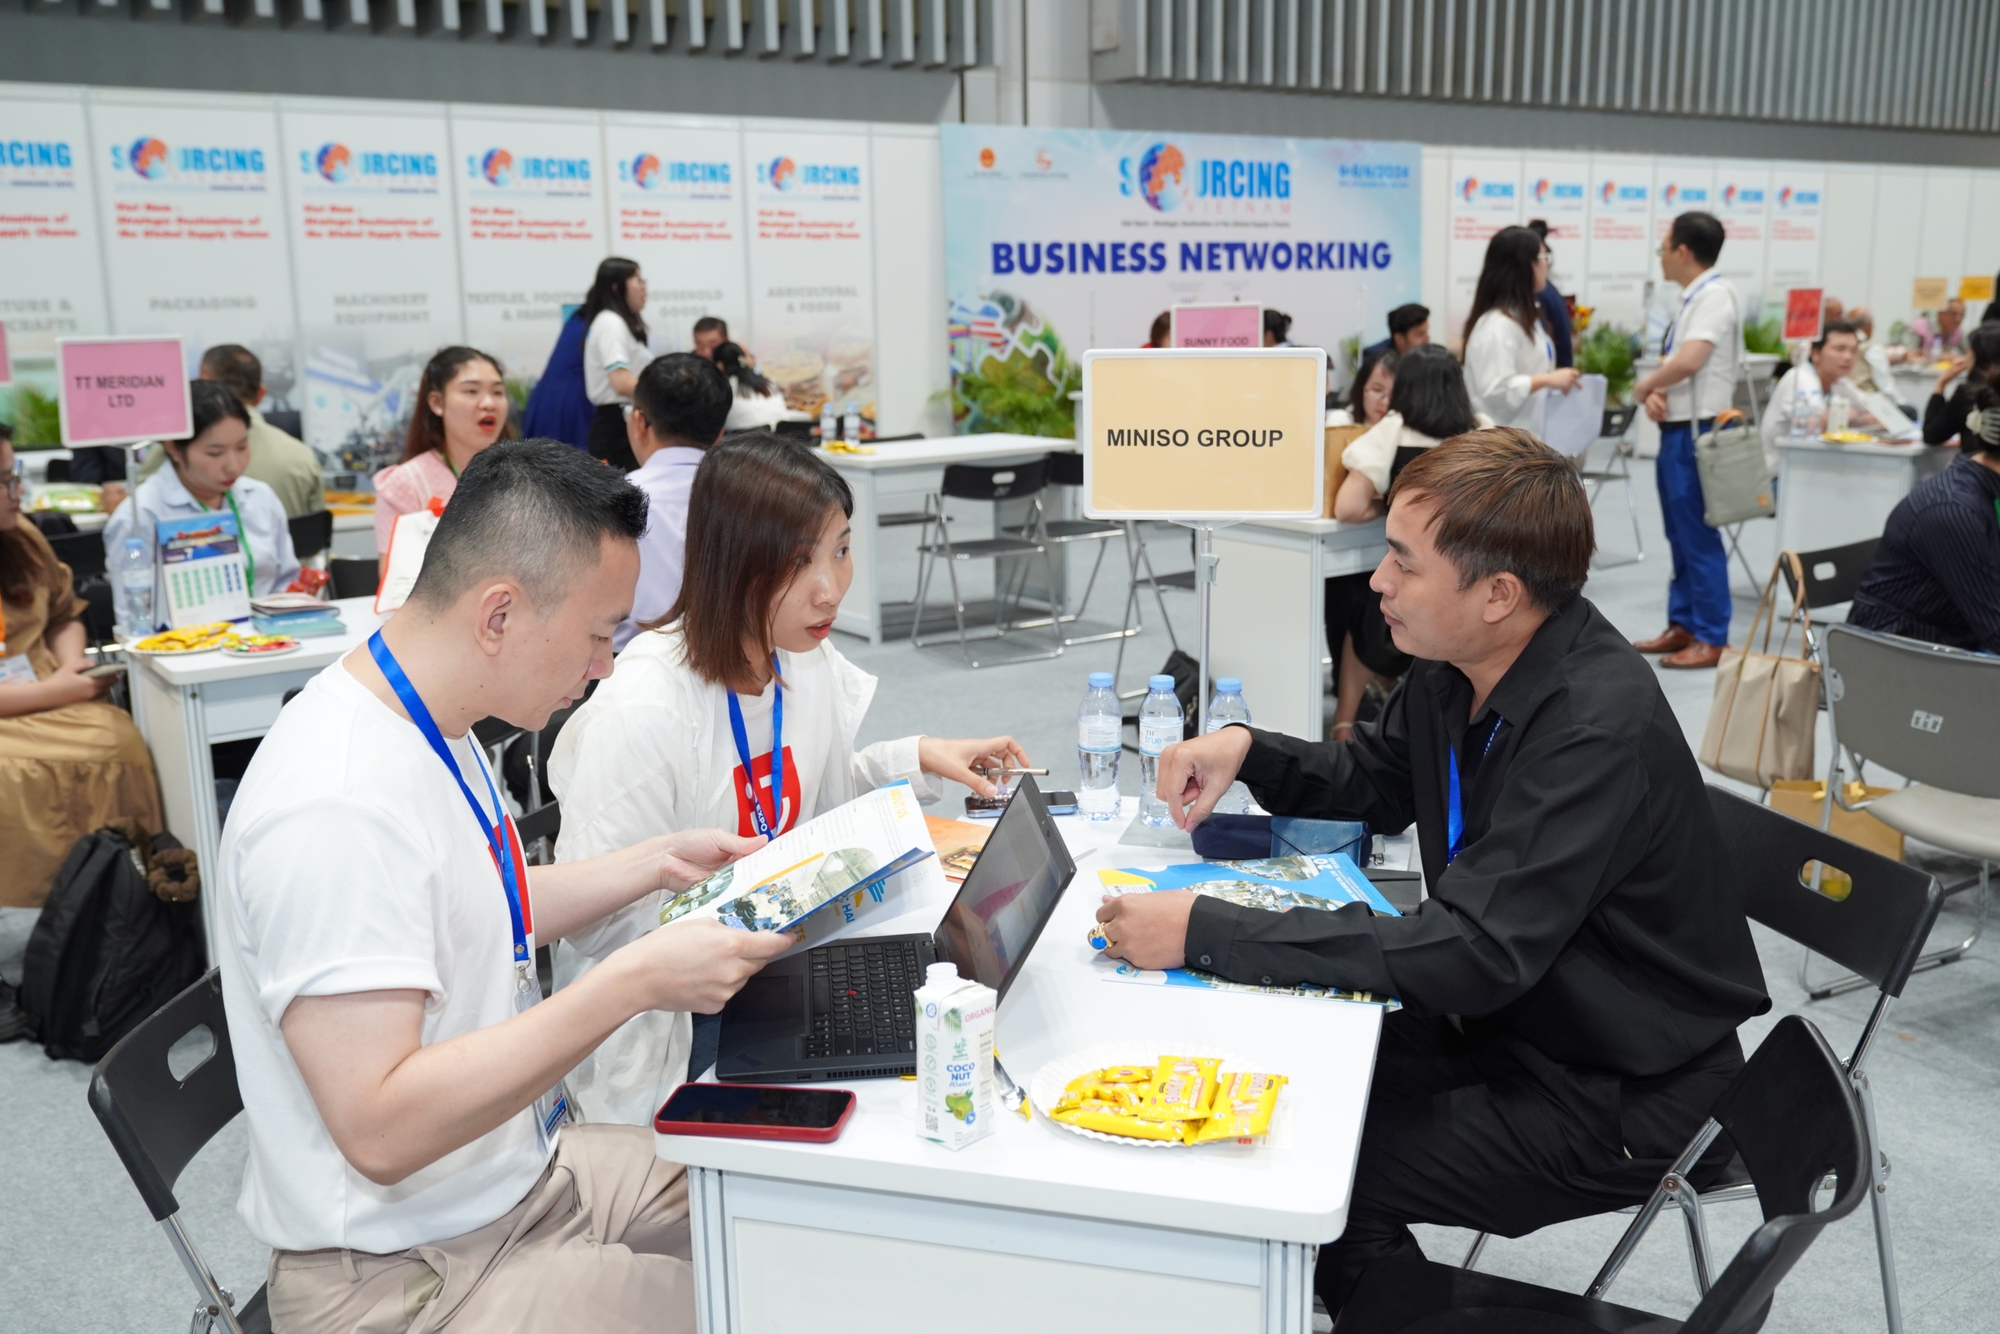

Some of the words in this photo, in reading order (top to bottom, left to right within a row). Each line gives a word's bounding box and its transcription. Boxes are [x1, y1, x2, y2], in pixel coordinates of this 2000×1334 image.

[992, 242, 1166, 274] BUSINESS
[1180, 242, 1391, 272] NETWORKING
[648, 290, 723, 301] OUSEHOLD
[1184, 338, 1218, 347] SUNNY
[1221, 337, 1249, 346] FOOD
[74, 376, 91, 390] TT
[96, 375, 164, 389] MERIDIAN
[108, 394, 135, 408] LTD
[1108, 429, 1190, 447] MINISO
[1197, 429, 1283, 448] GROUP
[1146, 736, 1162, 744] true
[890, 788, 906, 808] ABOUT
[756, 804, 768, 832] EXPO
[896, 808, 909, 819] US
[842, 904, 855, 924] HAI
[965, 1004, 994, 1022] ORGANIC
[946, 1062, 975, 1072] COCO
[952, 1072, 971, 1081] NUT
